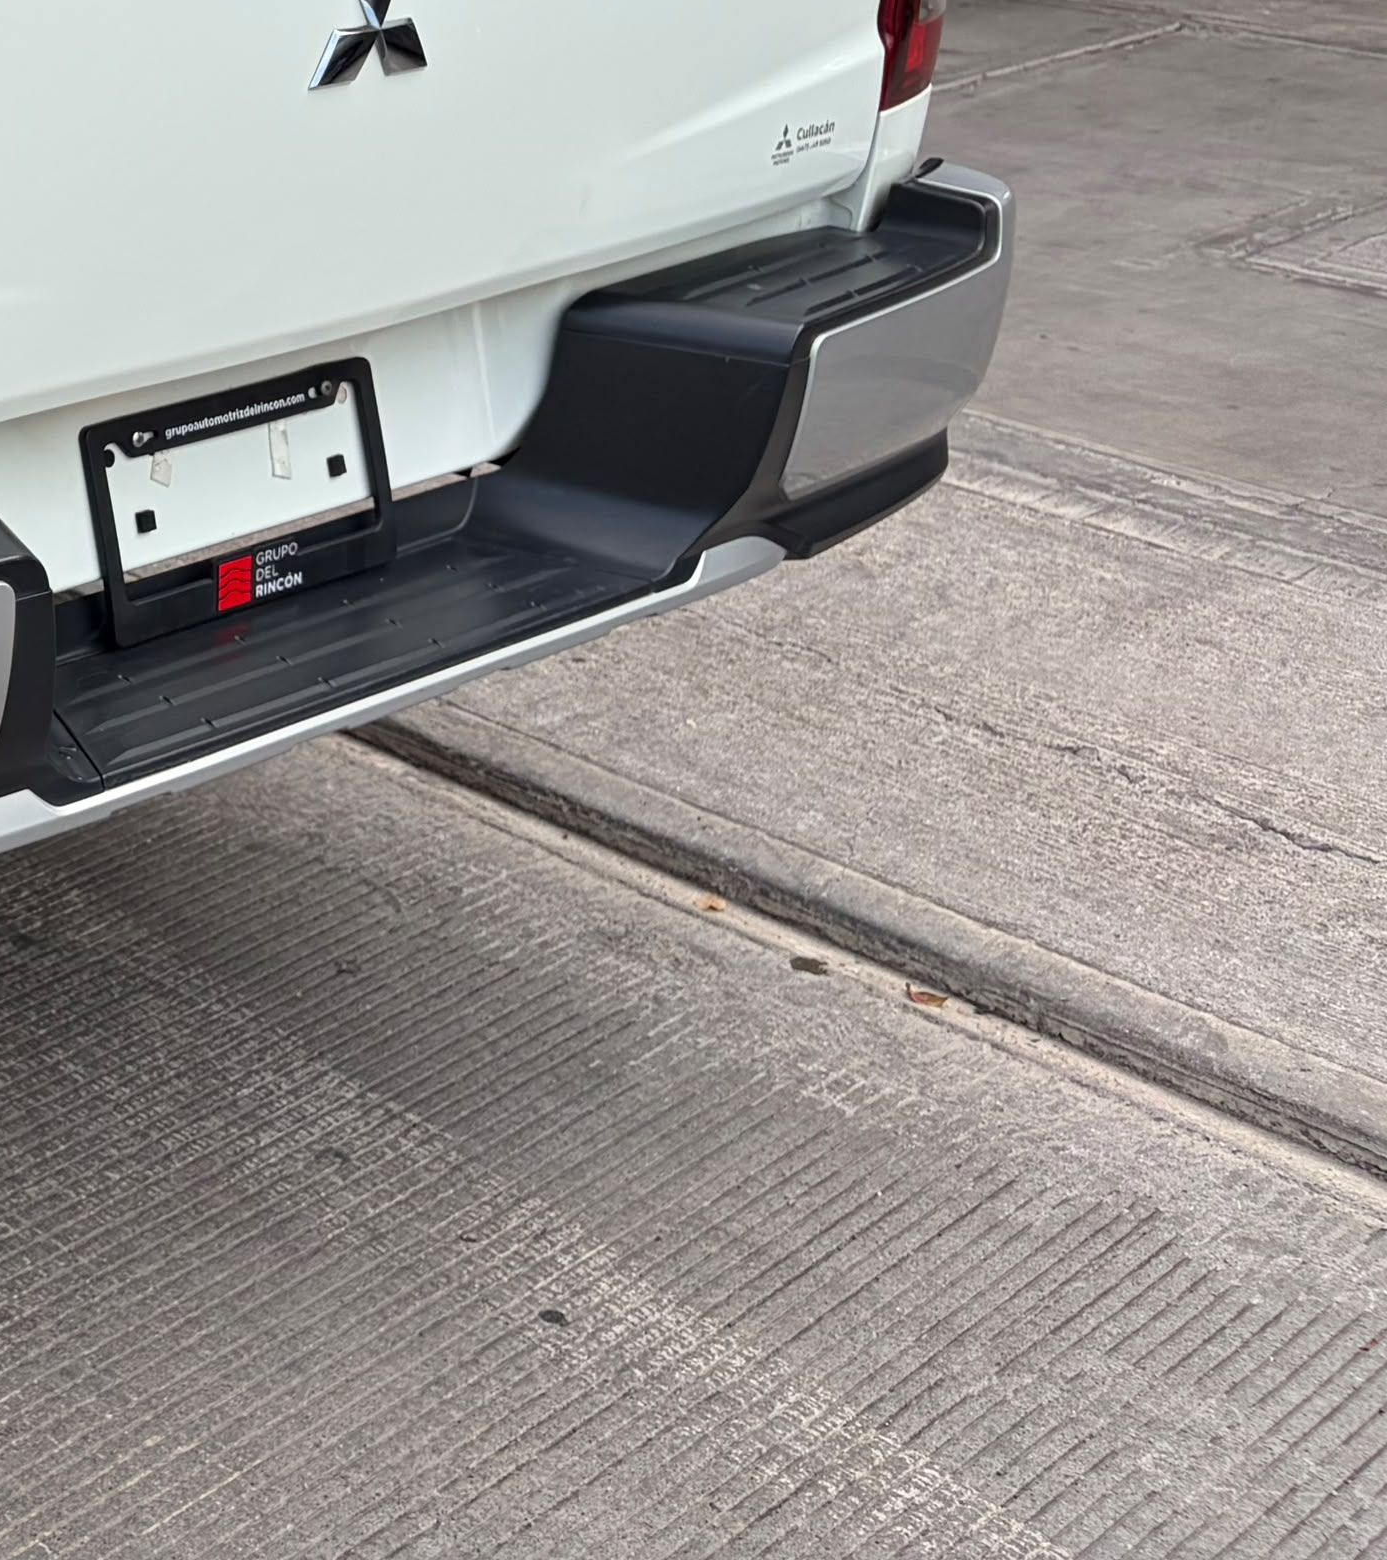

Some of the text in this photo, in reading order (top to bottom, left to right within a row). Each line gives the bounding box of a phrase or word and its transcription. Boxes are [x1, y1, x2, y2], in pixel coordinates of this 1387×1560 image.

[165, 392, 306, 440] grupoautomotrizdelrincon.com
[255, 541, 298, 566] GRUPO
[255, 564, 279, 582] DEL
[255, 571, 303, 598] RINCÓN
